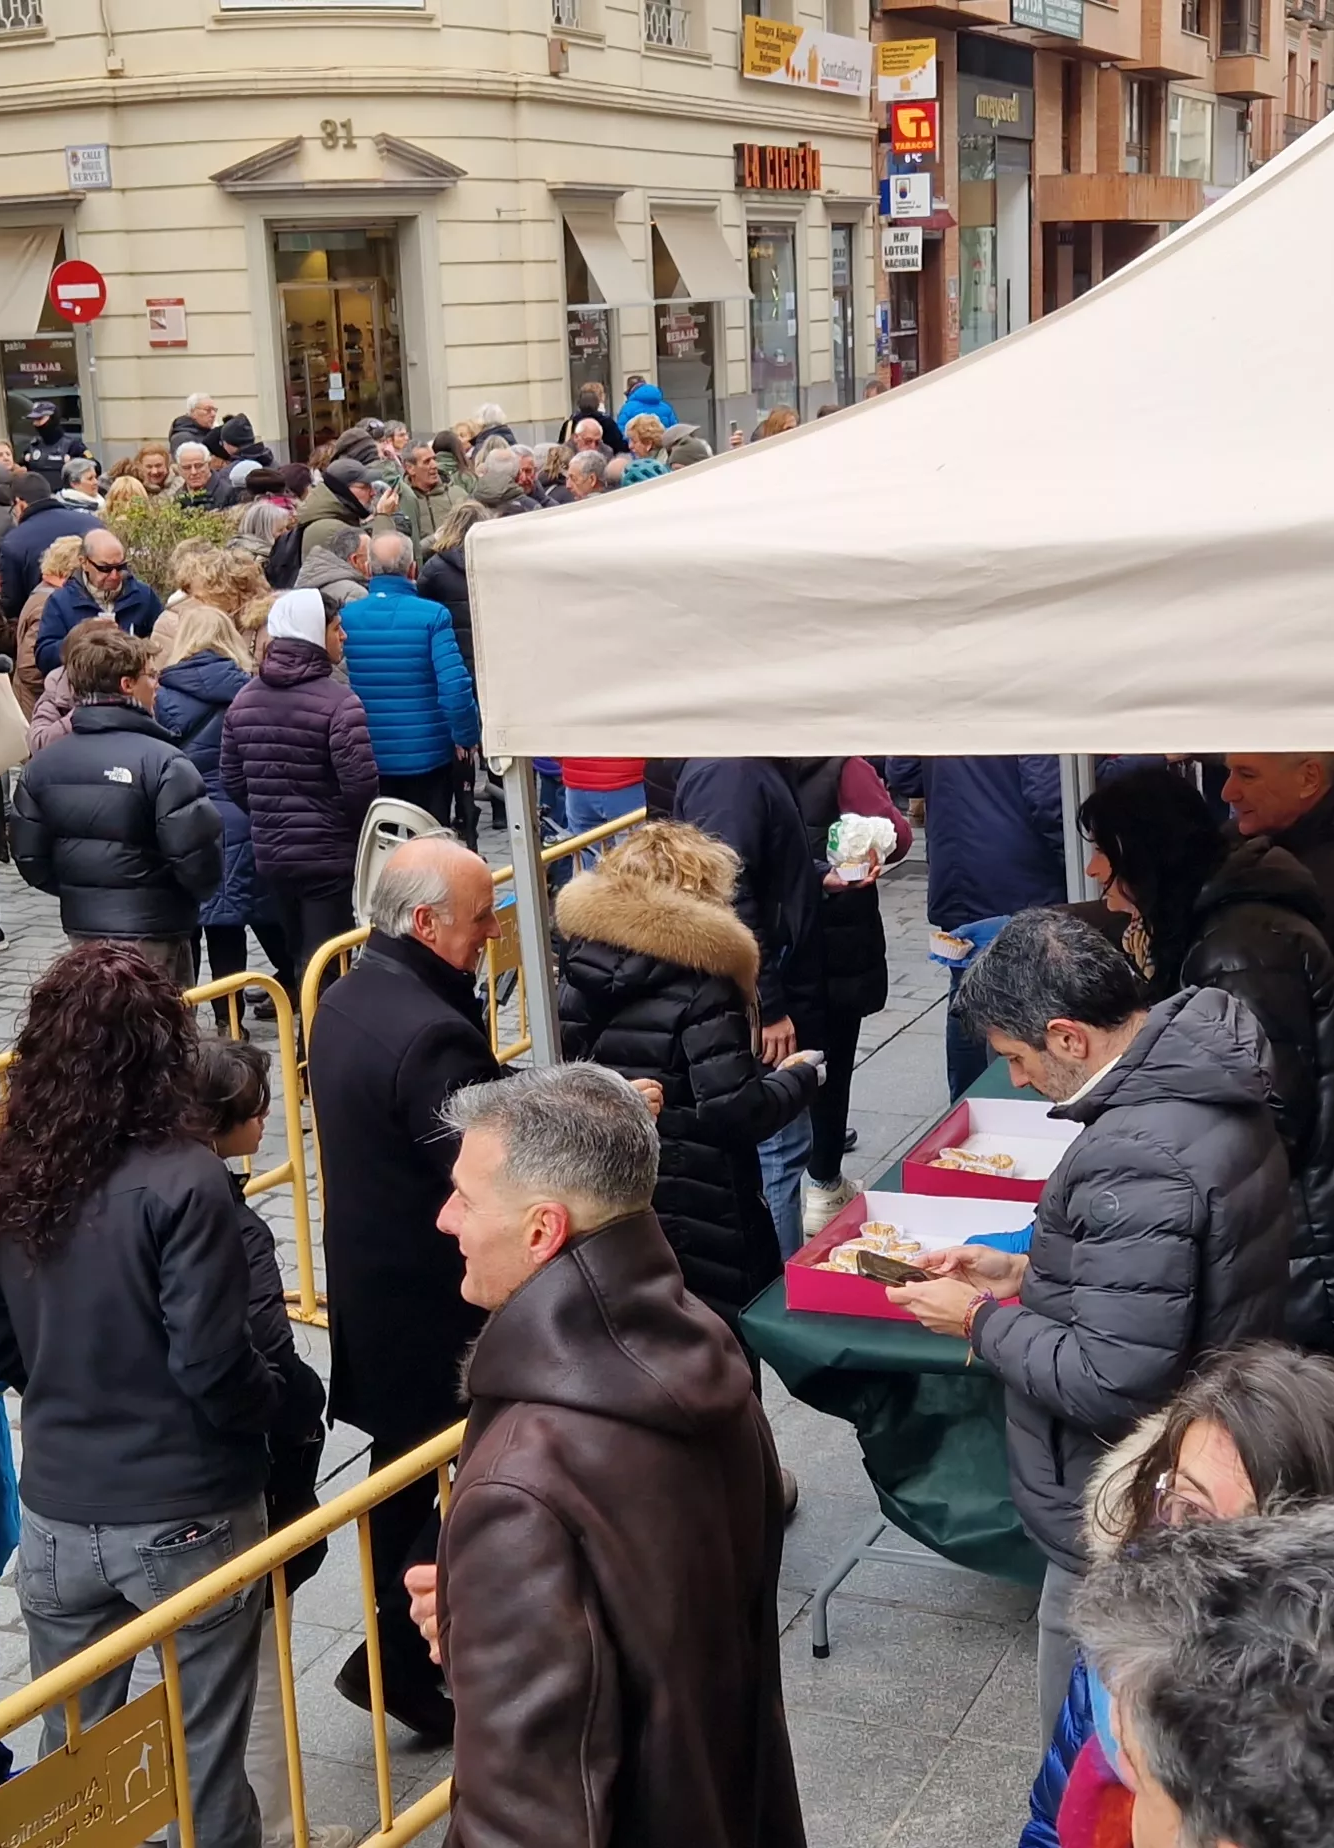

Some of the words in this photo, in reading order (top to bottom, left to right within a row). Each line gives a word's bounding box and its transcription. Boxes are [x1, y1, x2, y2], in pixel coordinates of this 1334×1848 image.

[895, 141, 934, 150] TABACOS
[81, 151, 102, 160] CALLE
[744, 144, 761, 188] LA
[72, 171, 106, 182] SERVET
[893, 232, 910, 242] HAY
[884, 245, 919, 256] LOTERIA
[884, 258, 919, 268] NACIONAL
[667, 328, 700, 343] REBAJAS
[20, 362, 62, 372] REBAJAS
